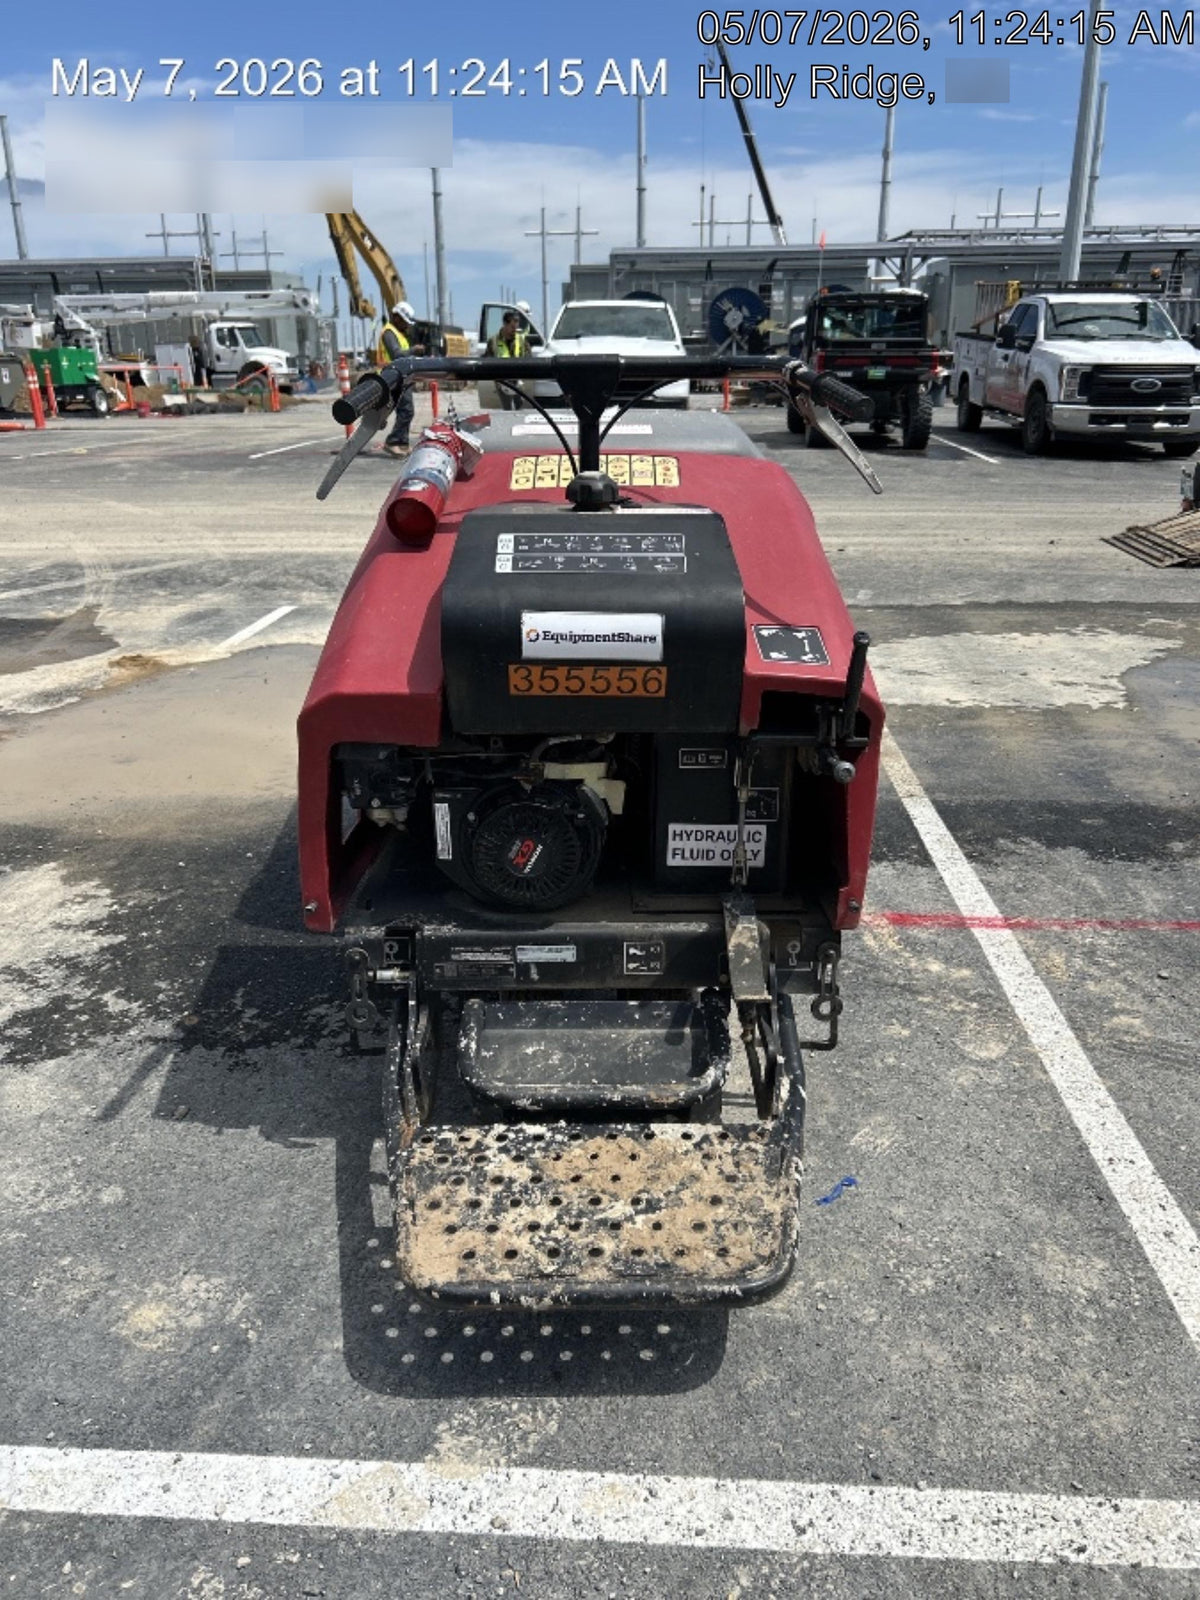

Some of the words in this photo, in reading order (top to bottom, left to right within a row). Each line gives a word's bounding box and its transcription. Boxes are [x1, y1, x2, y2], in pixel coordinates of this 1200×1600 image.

[541, 630, 657, 644] EquipmentShare
[513, 666, 663, 694] 355556
[671, 848, 716, 860] FLUID
